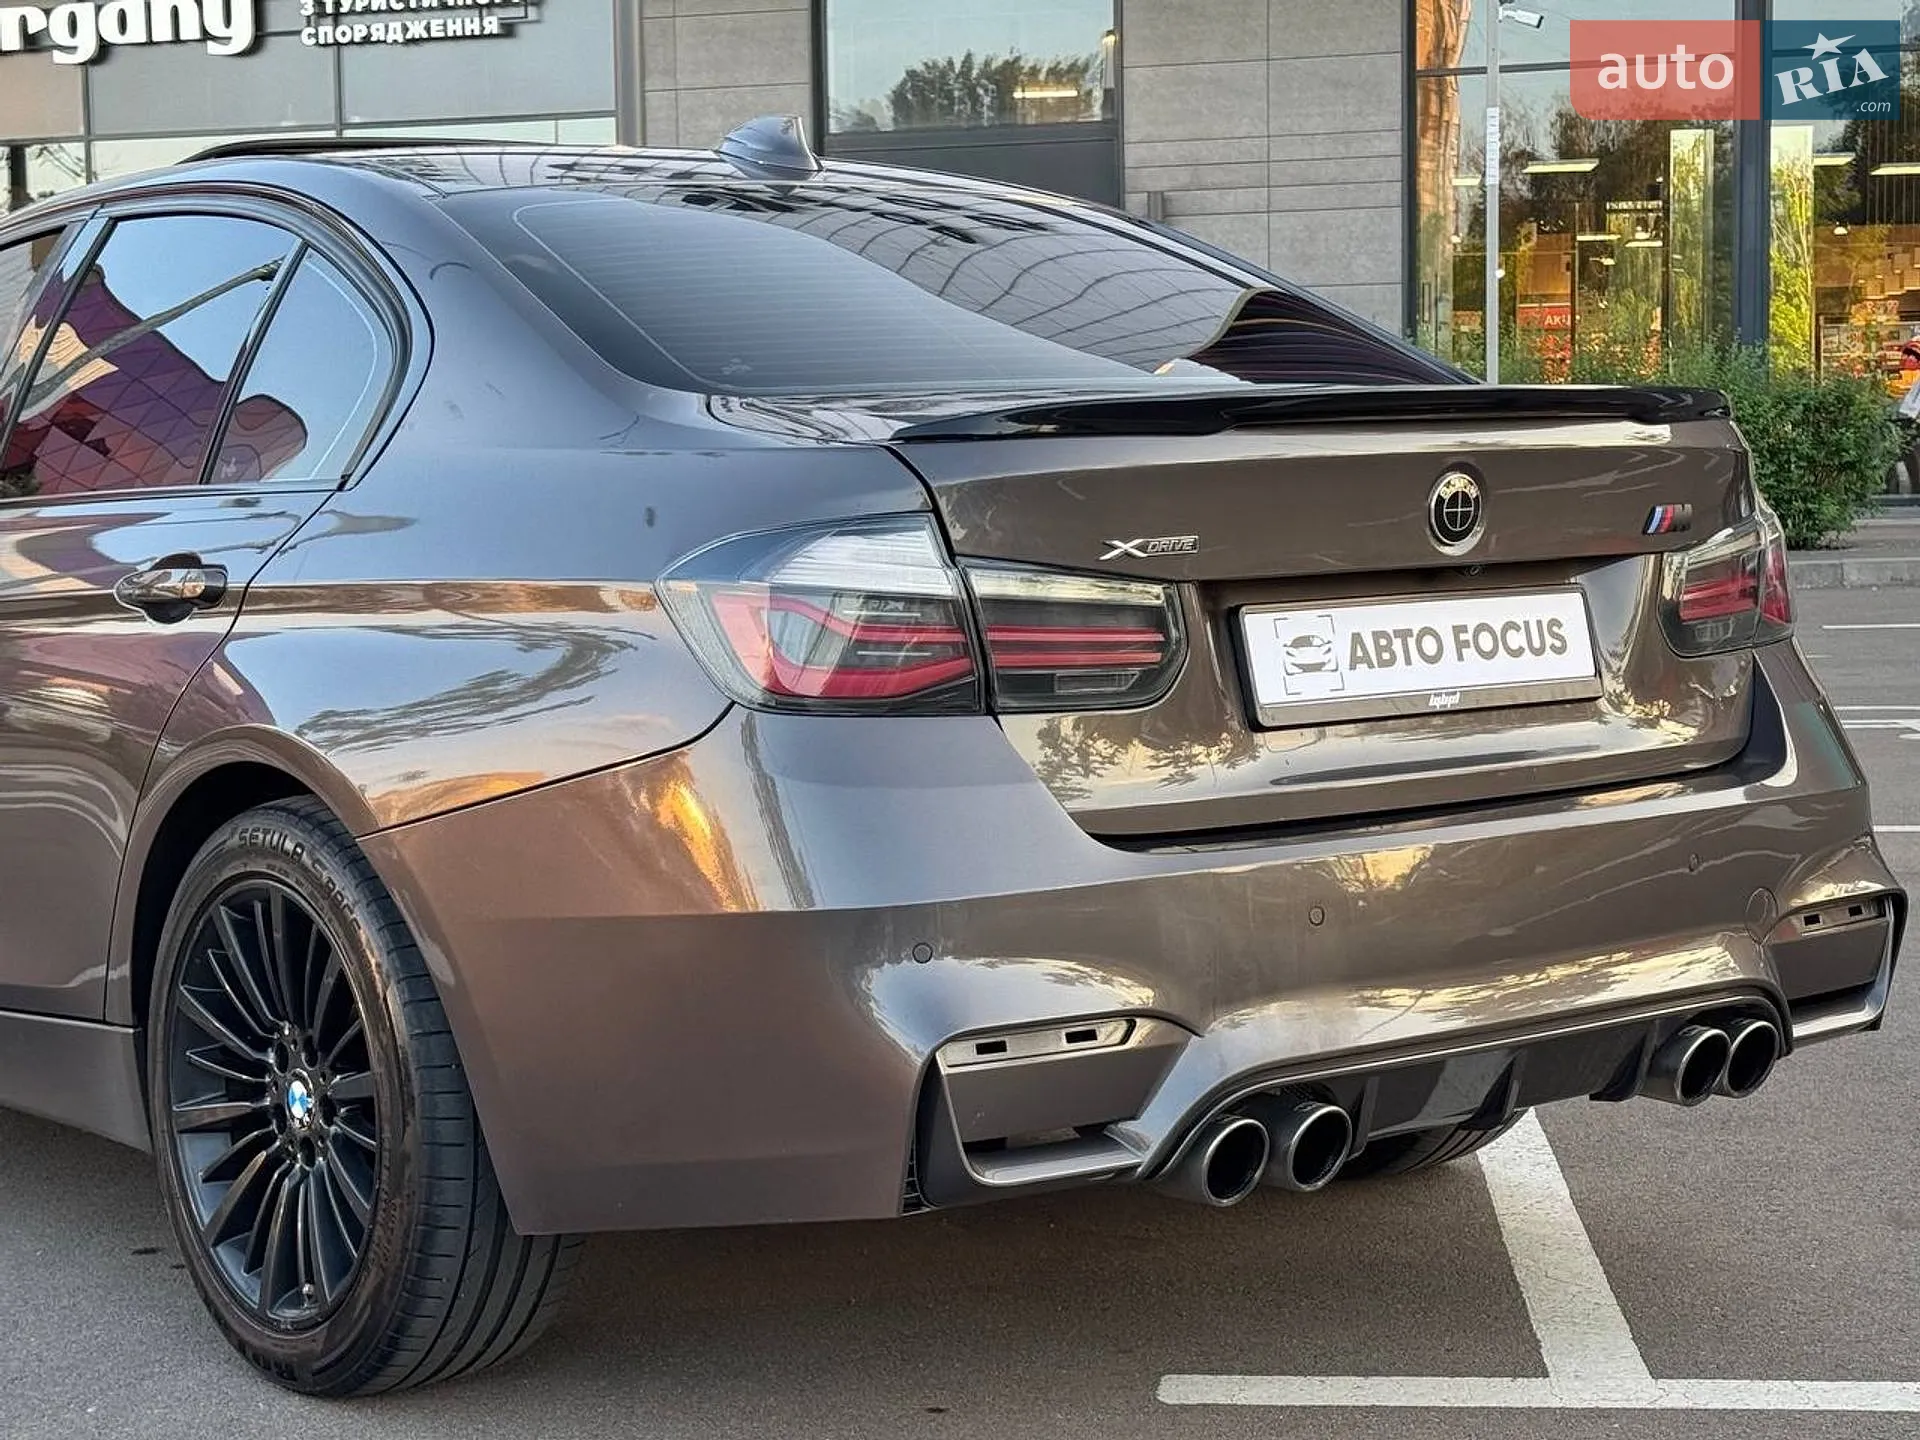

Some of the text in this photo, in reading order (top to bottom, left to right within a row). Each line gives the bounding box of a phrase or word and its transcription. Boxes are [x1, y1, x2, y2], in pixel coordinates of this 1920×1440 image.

[320, 0, 521, 14] ТУРИСТИ
[300, 16, 499, 46] СПОРЯДЖЕННЯ
[1348, 617, 1569, 671] АВТО FOCUS
